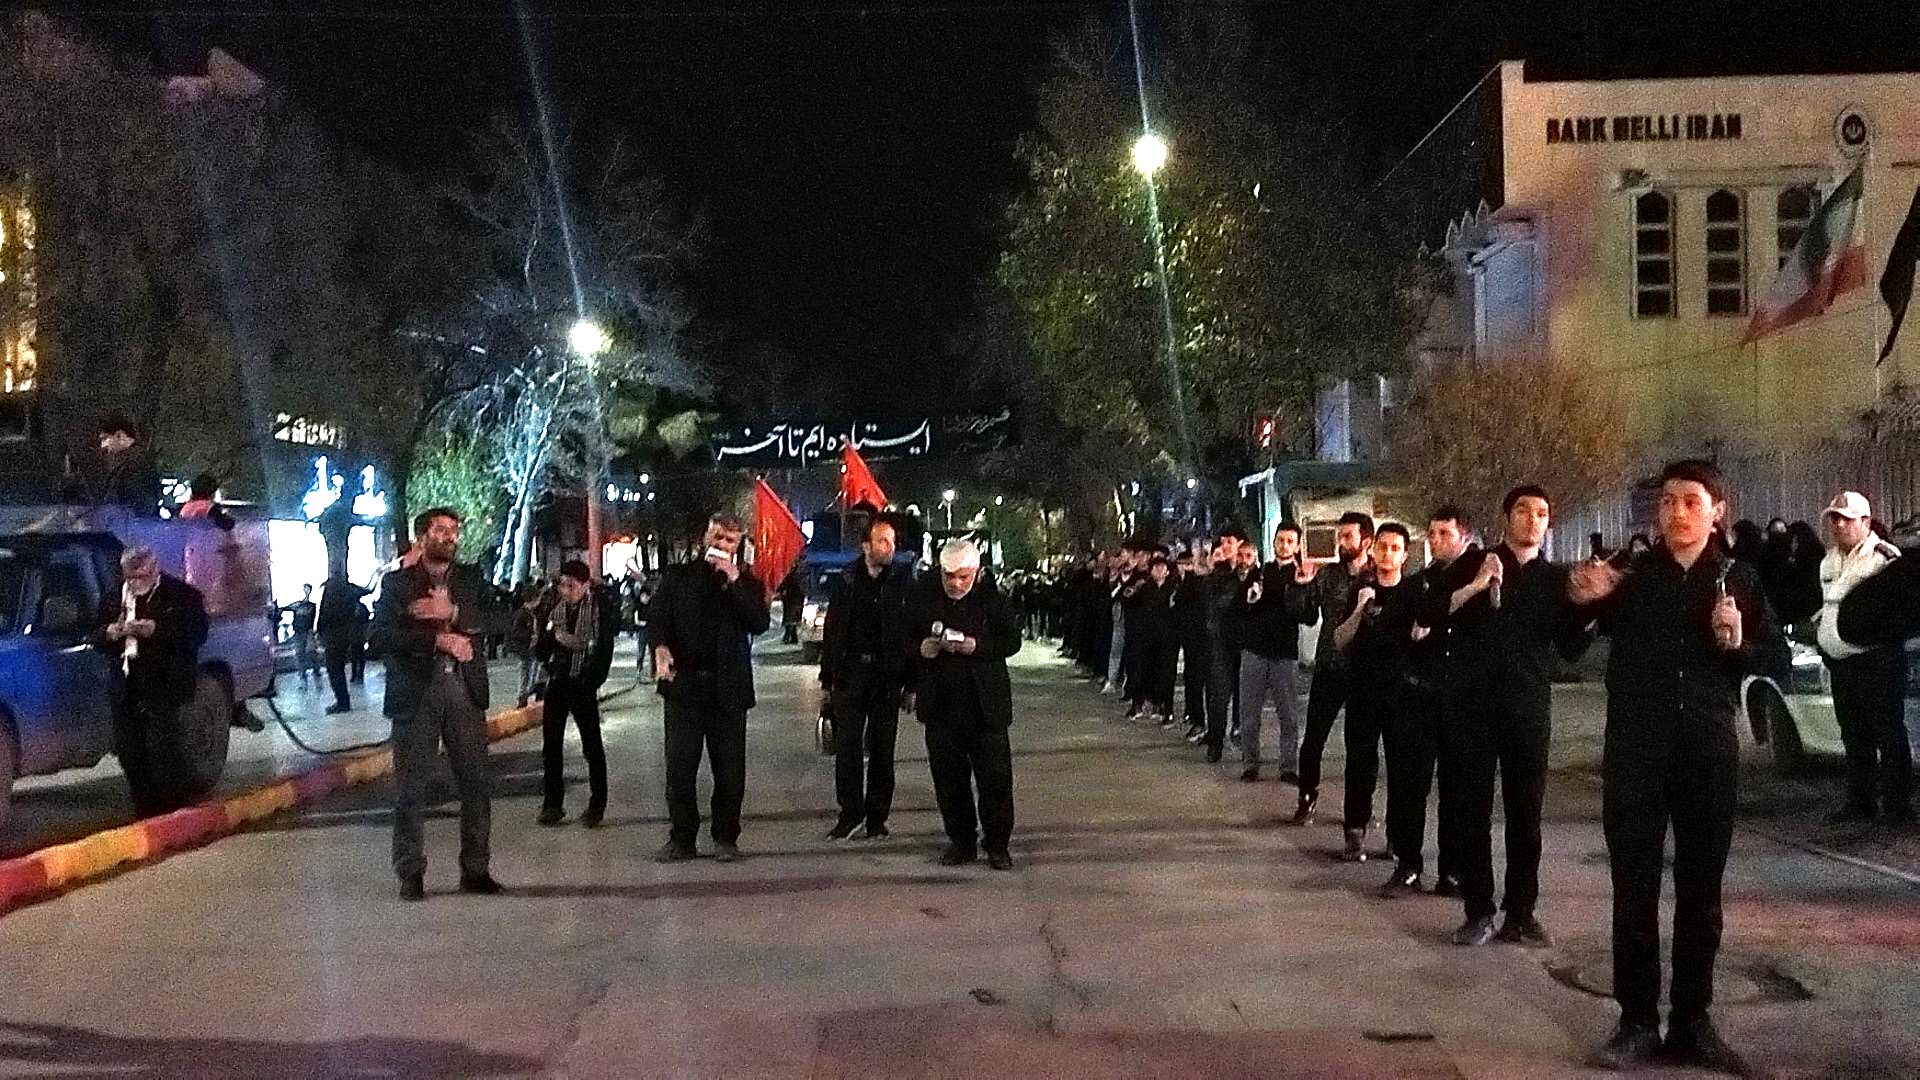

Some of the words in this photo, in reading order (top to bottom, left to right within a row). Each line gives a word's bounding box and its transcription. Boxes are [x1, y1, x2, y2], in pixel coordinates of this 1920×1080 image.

[1546, 116, 1607, 145] BANK
[1613, 114, 1680, 142] MELLI
[1686, 113, 1742, 140] IRAN
[717, 422, 788, 461] آخر
[788, 426, 805, 457] تا
